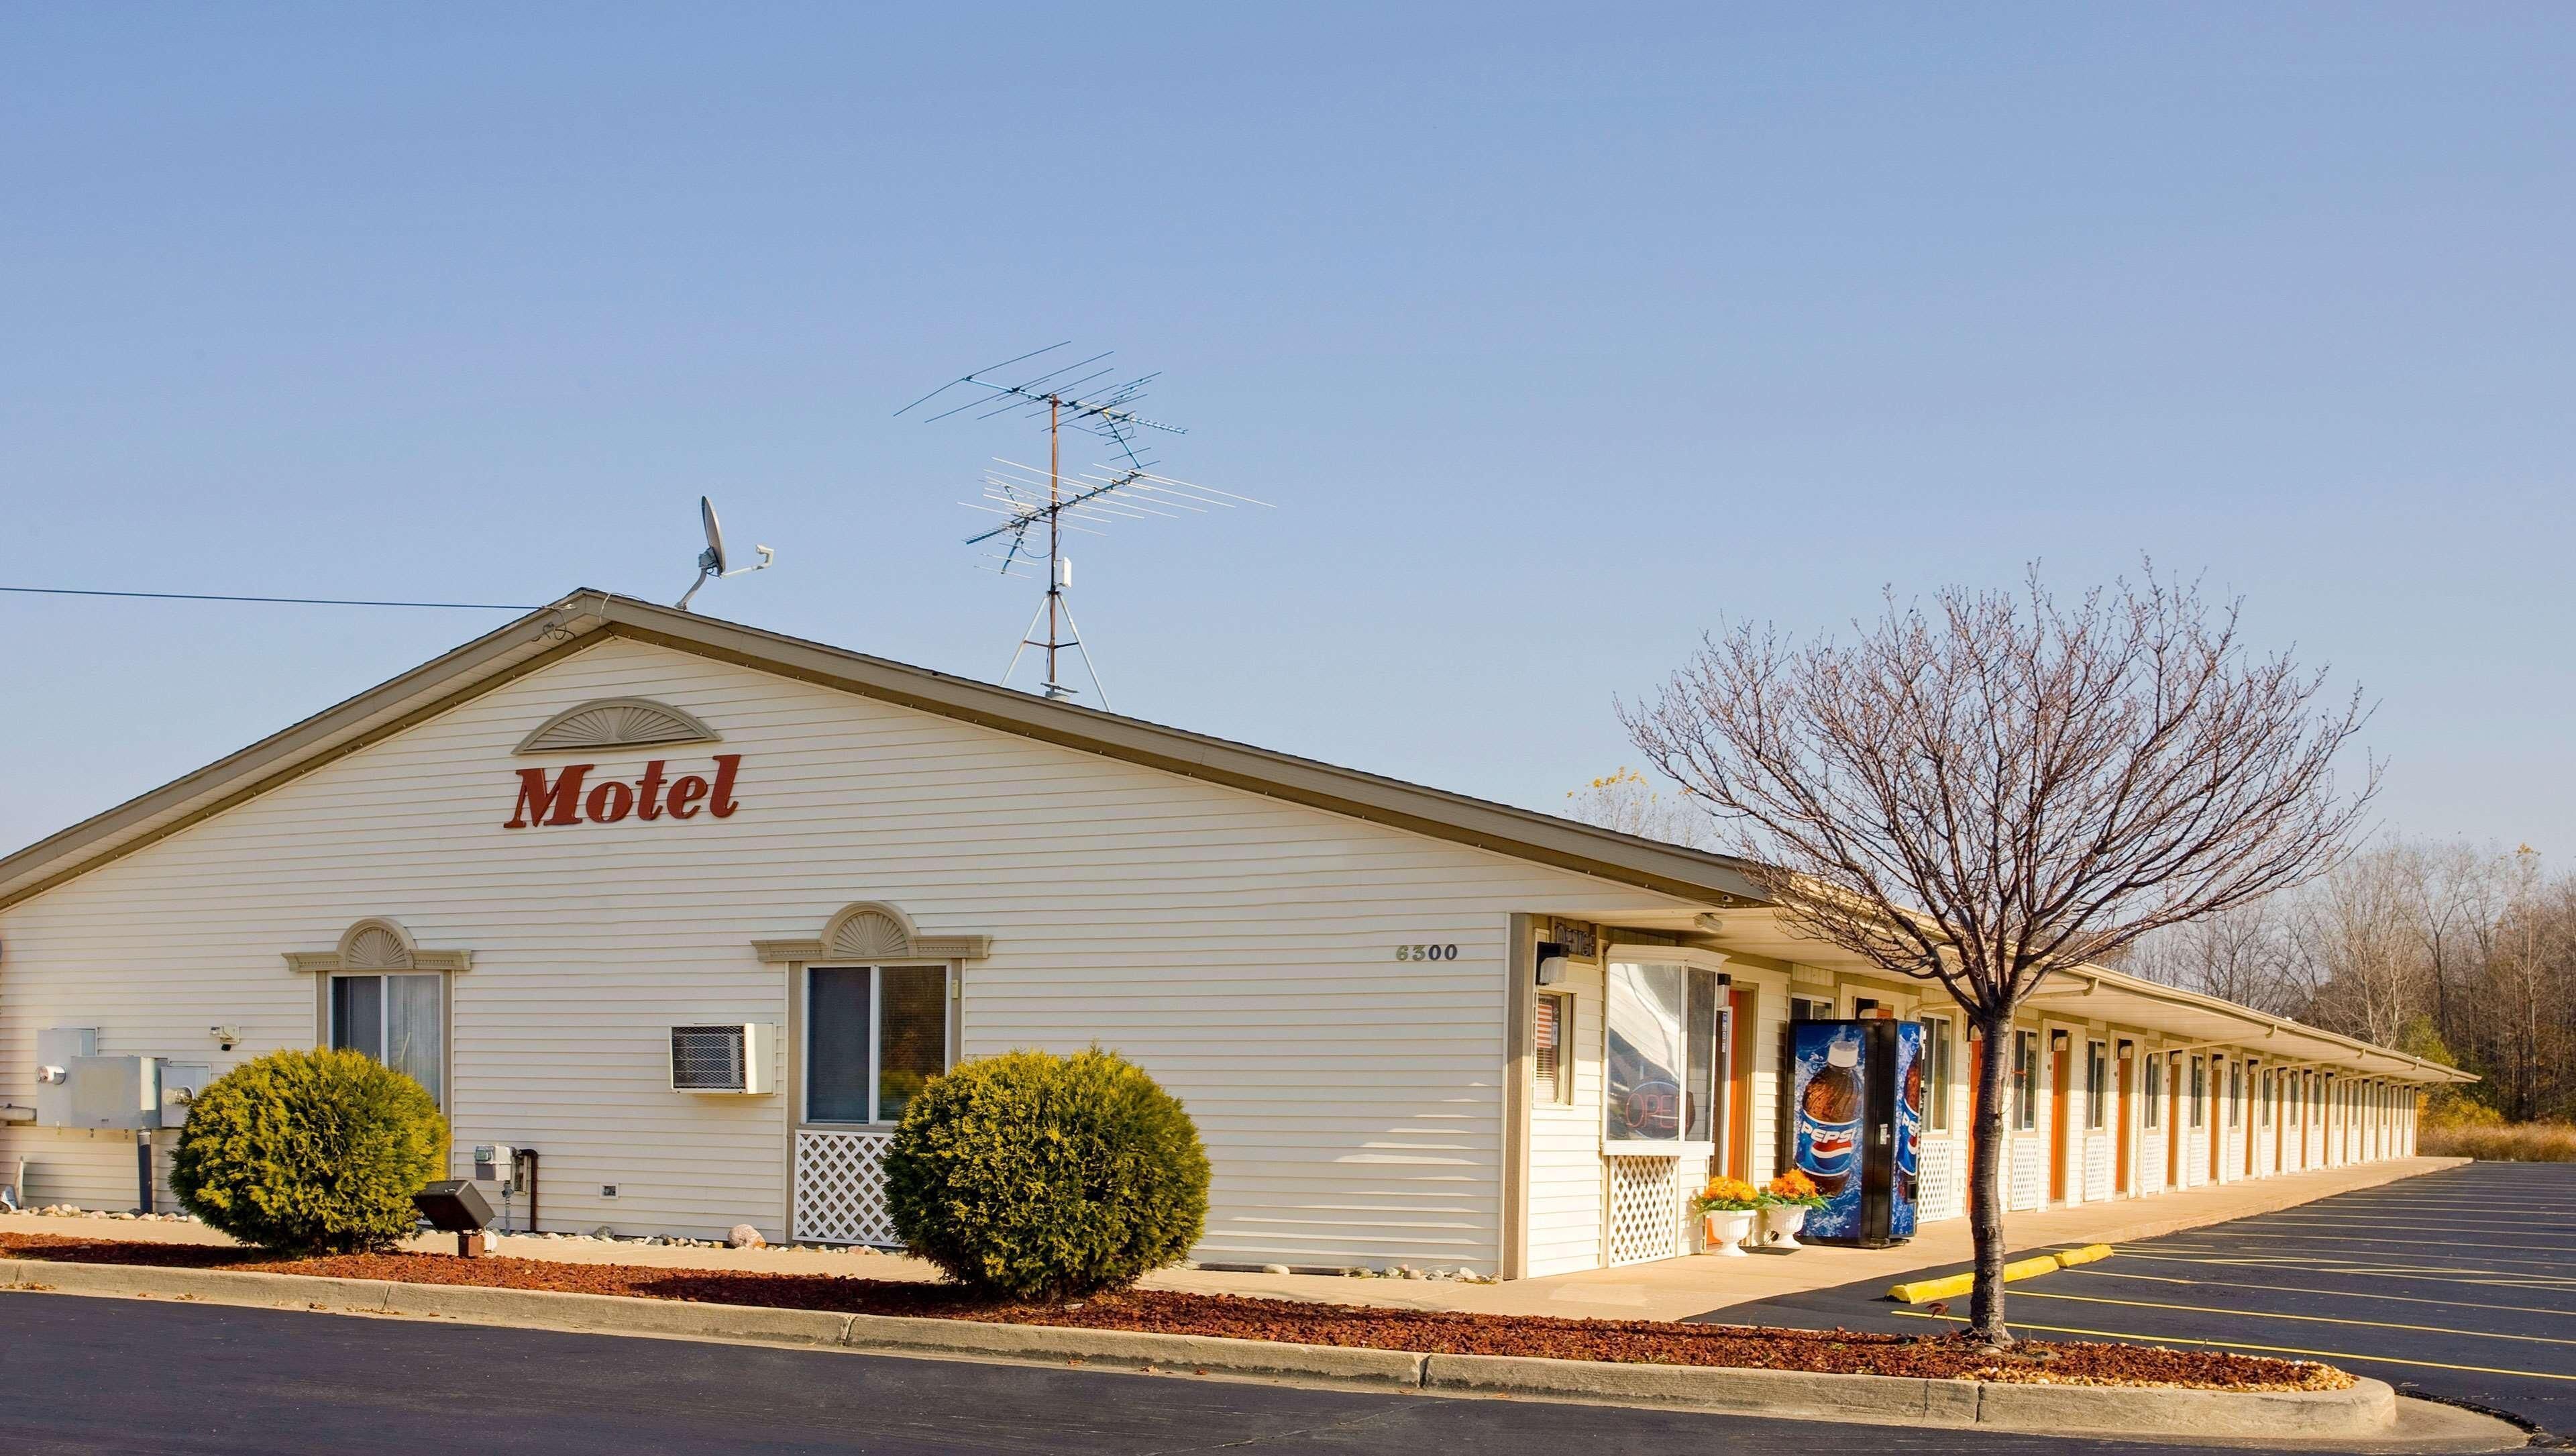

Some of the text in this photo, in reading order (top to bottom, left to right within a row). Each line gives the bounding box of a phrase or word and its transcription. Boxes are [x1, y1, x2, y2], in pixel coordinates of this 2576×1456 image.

[503, 754, 742, 829] Motel
[1396, 944, 1458, 961] 6300
[1801, 1121, 1858, 1143] PEPSI
